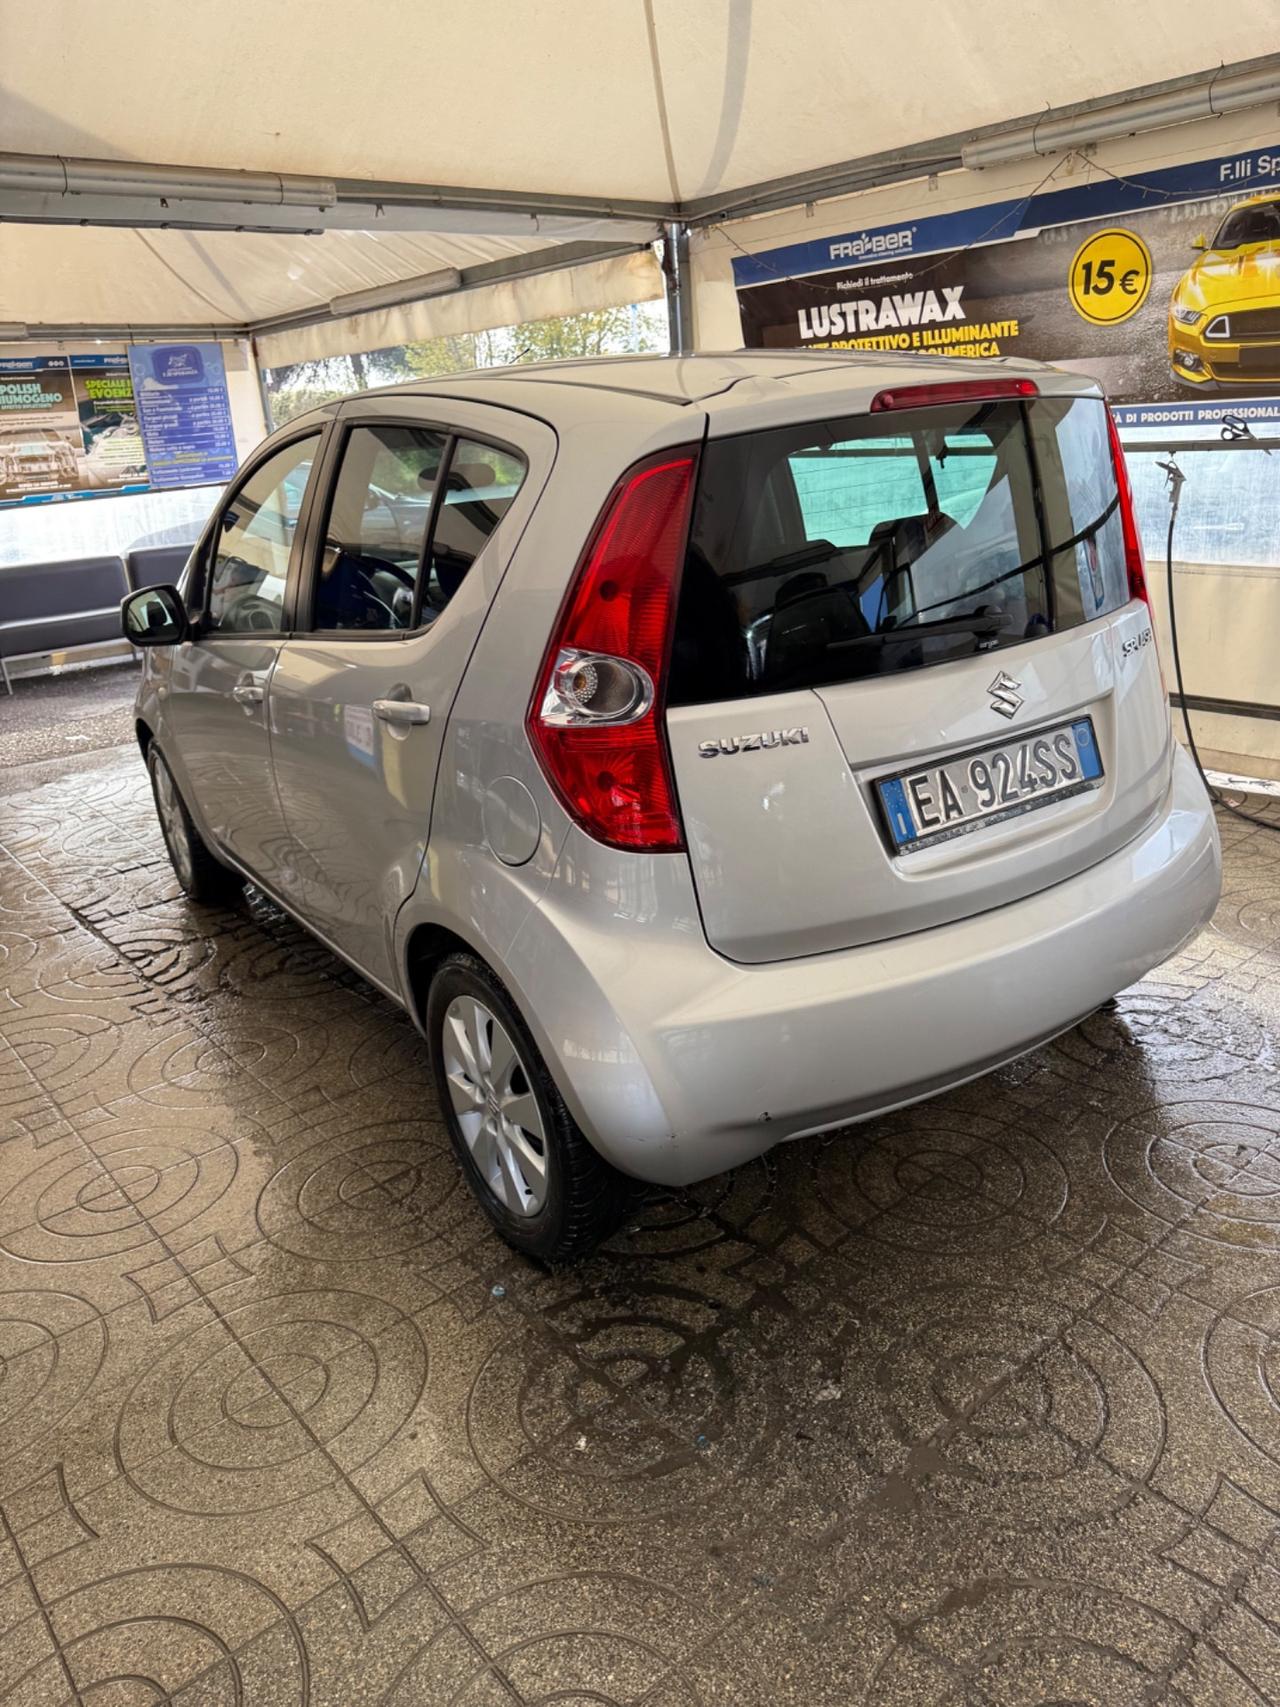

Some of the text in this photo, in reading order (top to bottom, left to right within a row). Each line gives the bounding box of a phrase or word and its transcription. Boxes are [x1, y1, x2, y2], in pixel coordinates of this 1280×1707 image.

[1220, 160, 1251, 181] F.lli
[836, 278, 864, 291] Richiedi
[870, 272, 914, 285] trattamento
[798, 286, 966, 339] LUSTRAWAX
[831, 333, 910, 351] PROTETTIVO
[912, 332, 921, 346] E
[923, 319, 1019, 345] ILLUMINANTE
[0, 383, 41, 395] POLISH
[1126, 413, 1137, 423] DI
[1140, 410, 1193, 422] PRODOTTI
[698, 727, 809, 759] SUZUKI
[908, 759, 963, 829] EA
[969, 733, 1079, 808] 924SS
